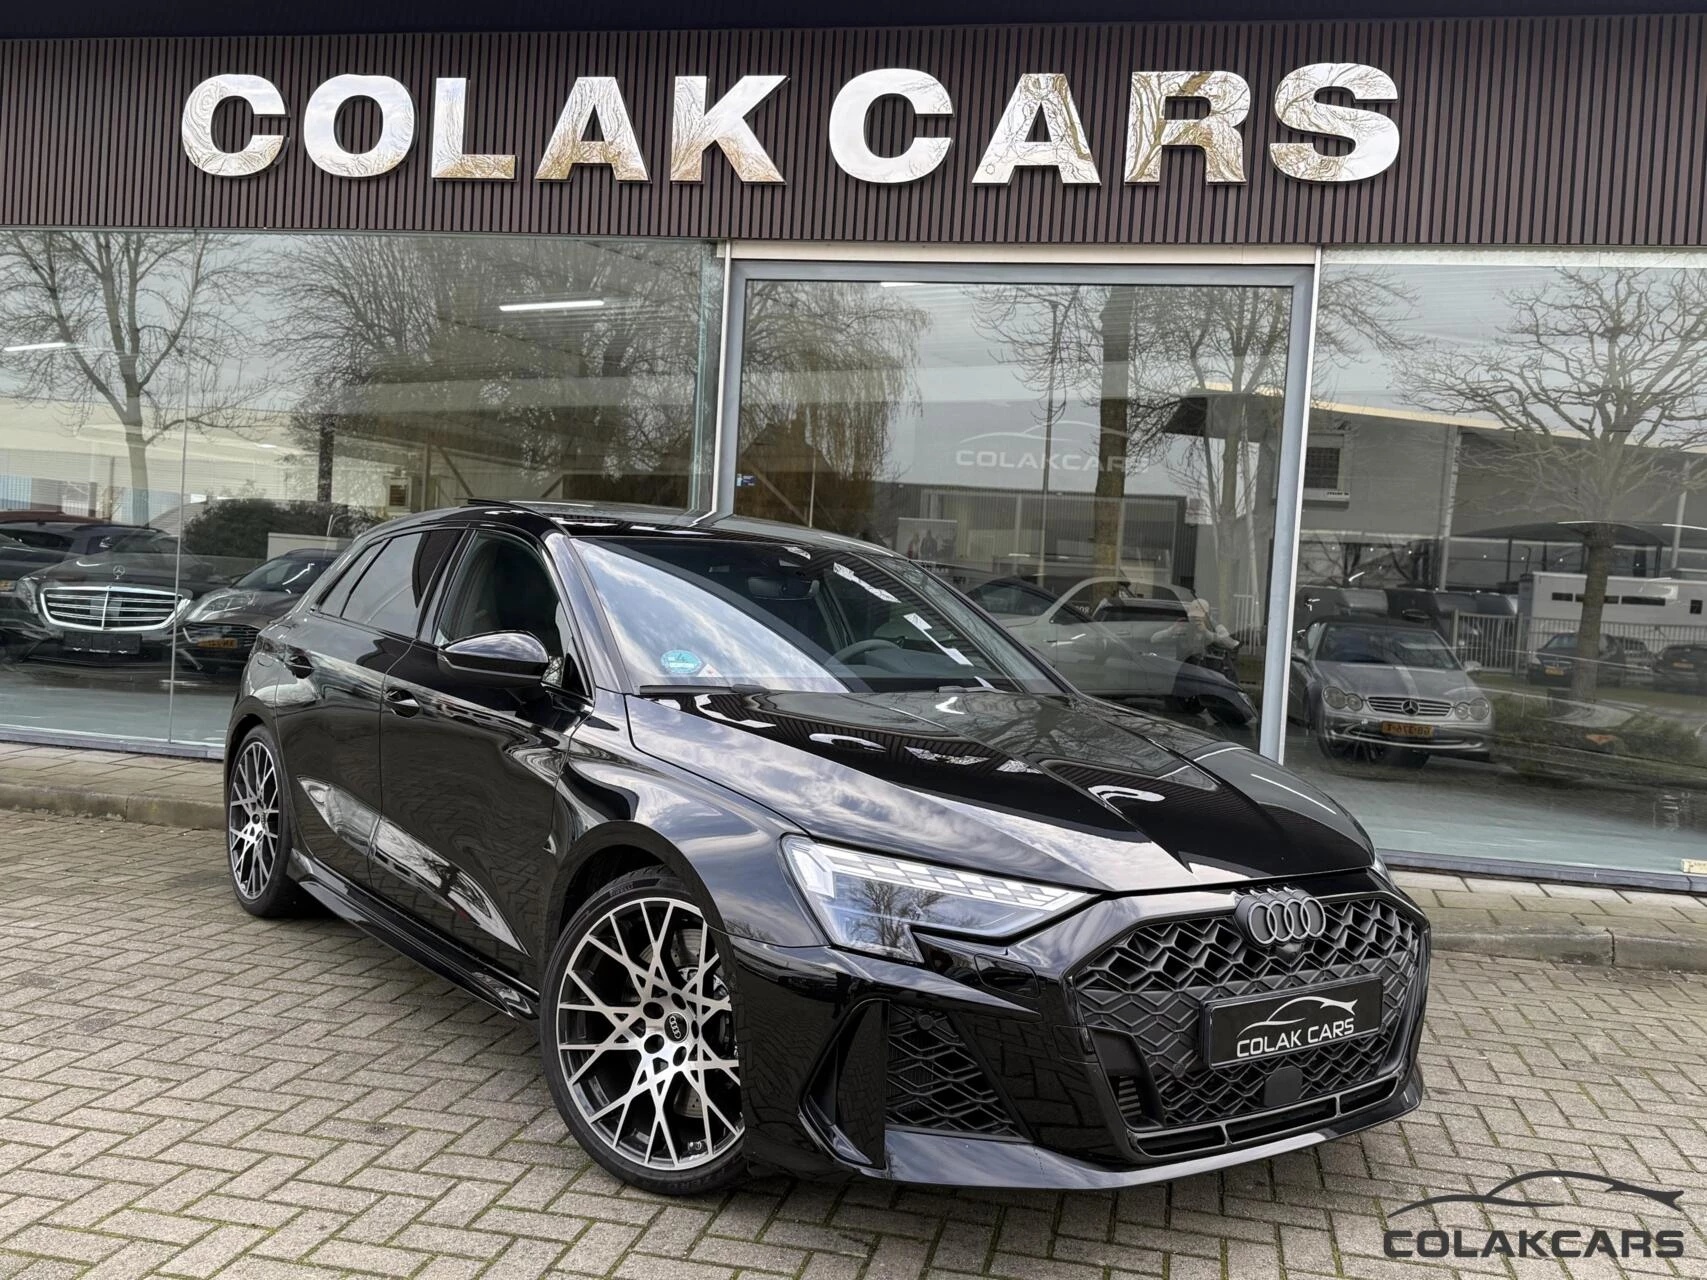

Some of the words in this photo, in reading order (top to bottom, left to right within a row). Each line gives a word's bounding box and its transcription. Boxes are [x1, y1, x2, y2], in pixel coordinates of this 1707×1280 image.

[181, 73, 788, 182] COLAK
[829, 62, 1400, 184] CARS
[1236, 1029, 1302, 1058] COLAK
[1307, 1018, 1355, 1044] CARS
